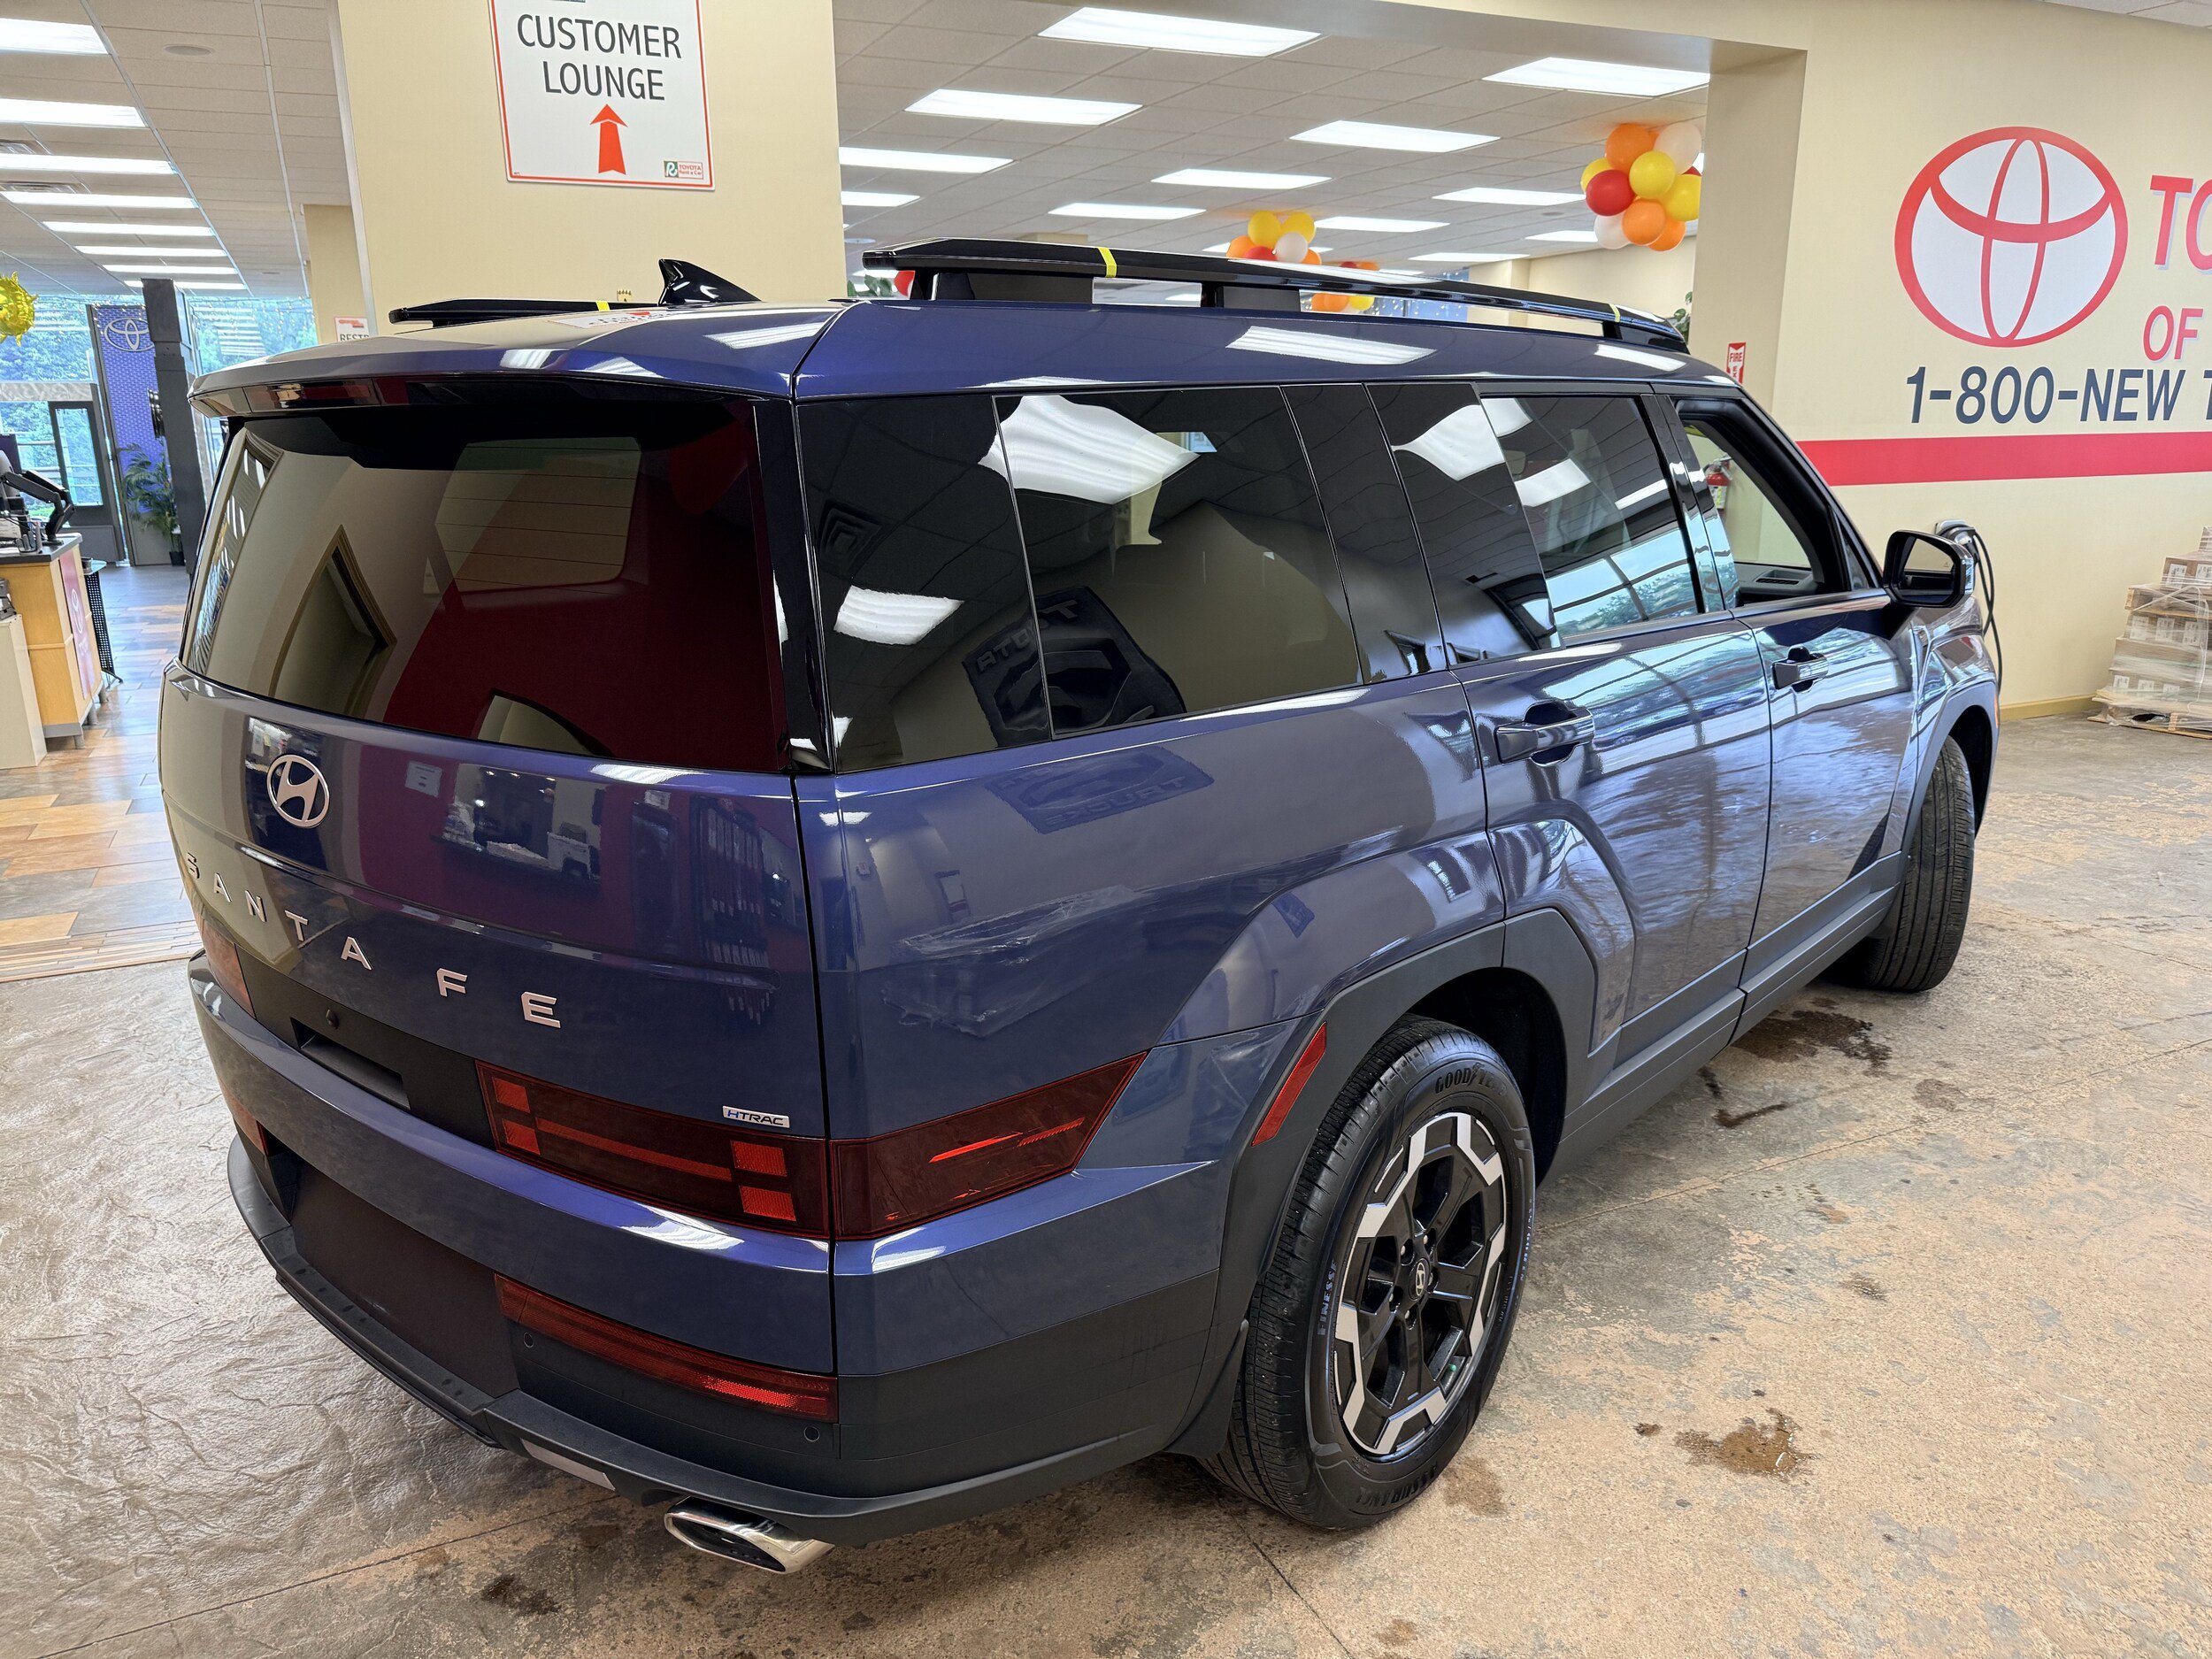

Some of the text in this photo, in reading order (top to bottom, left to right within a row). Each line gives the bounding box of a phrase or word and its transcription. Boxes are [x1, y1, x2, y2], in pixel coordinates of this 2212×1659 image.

[517, 14, 681, 58] CUSTOMER
[543, 61, 664, 100] LOUNGE
[2143, 305, 2204, 362] OF
[1729, 351, 1743, 363] FIRE
[1906, 365, 2186, 425] 1-800-NEW
[186, 851, 562, 1029] SANTA FE
[727, 1109, 784, 1126] HTRAC
